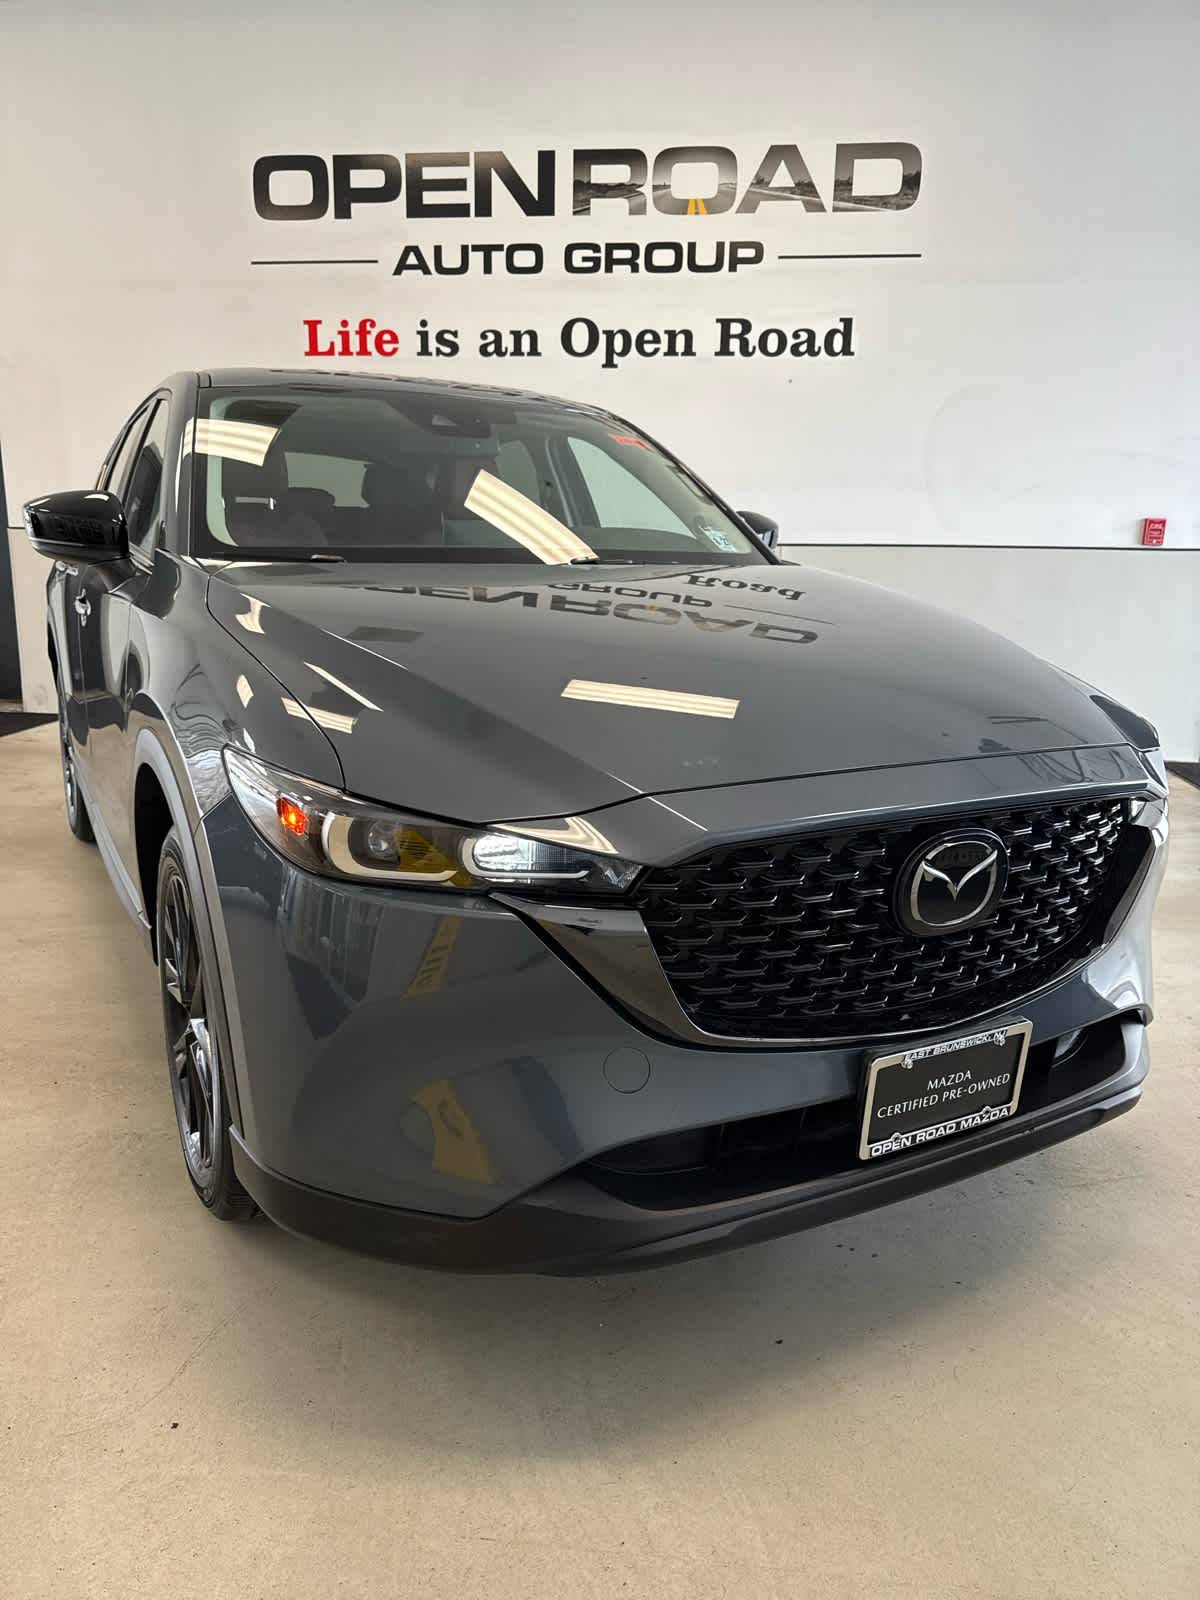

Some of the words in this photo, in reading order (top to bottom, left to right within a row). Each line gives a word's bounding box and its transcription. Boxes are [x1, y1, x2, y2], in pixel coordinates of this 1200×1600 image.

[252, 150, 555, 220] OPEN
[572, 142, 922, 216] ROAD
[392, 243, 544, 276] AUTO
[564, 240, 764, 274] GROUP
[303, 318, 399, 358] Life
[416, 318, 459, 358] is
[478, 327, 539, 357] an
[561, 317, 696, 368] Open
[716, 317, 855, 358] Road
[877, 1094, 939, 1119] CERTIFIED
[942, 1072, 1011, 1103] PRE-OWNED
[926, 1070, 973, 1091] MAZDA
[870, 1136, 913, 1157] OPEN
[915, 1122, 957, 1144] ROAD
[959, 1107, 1010, 1130] MAZDA
